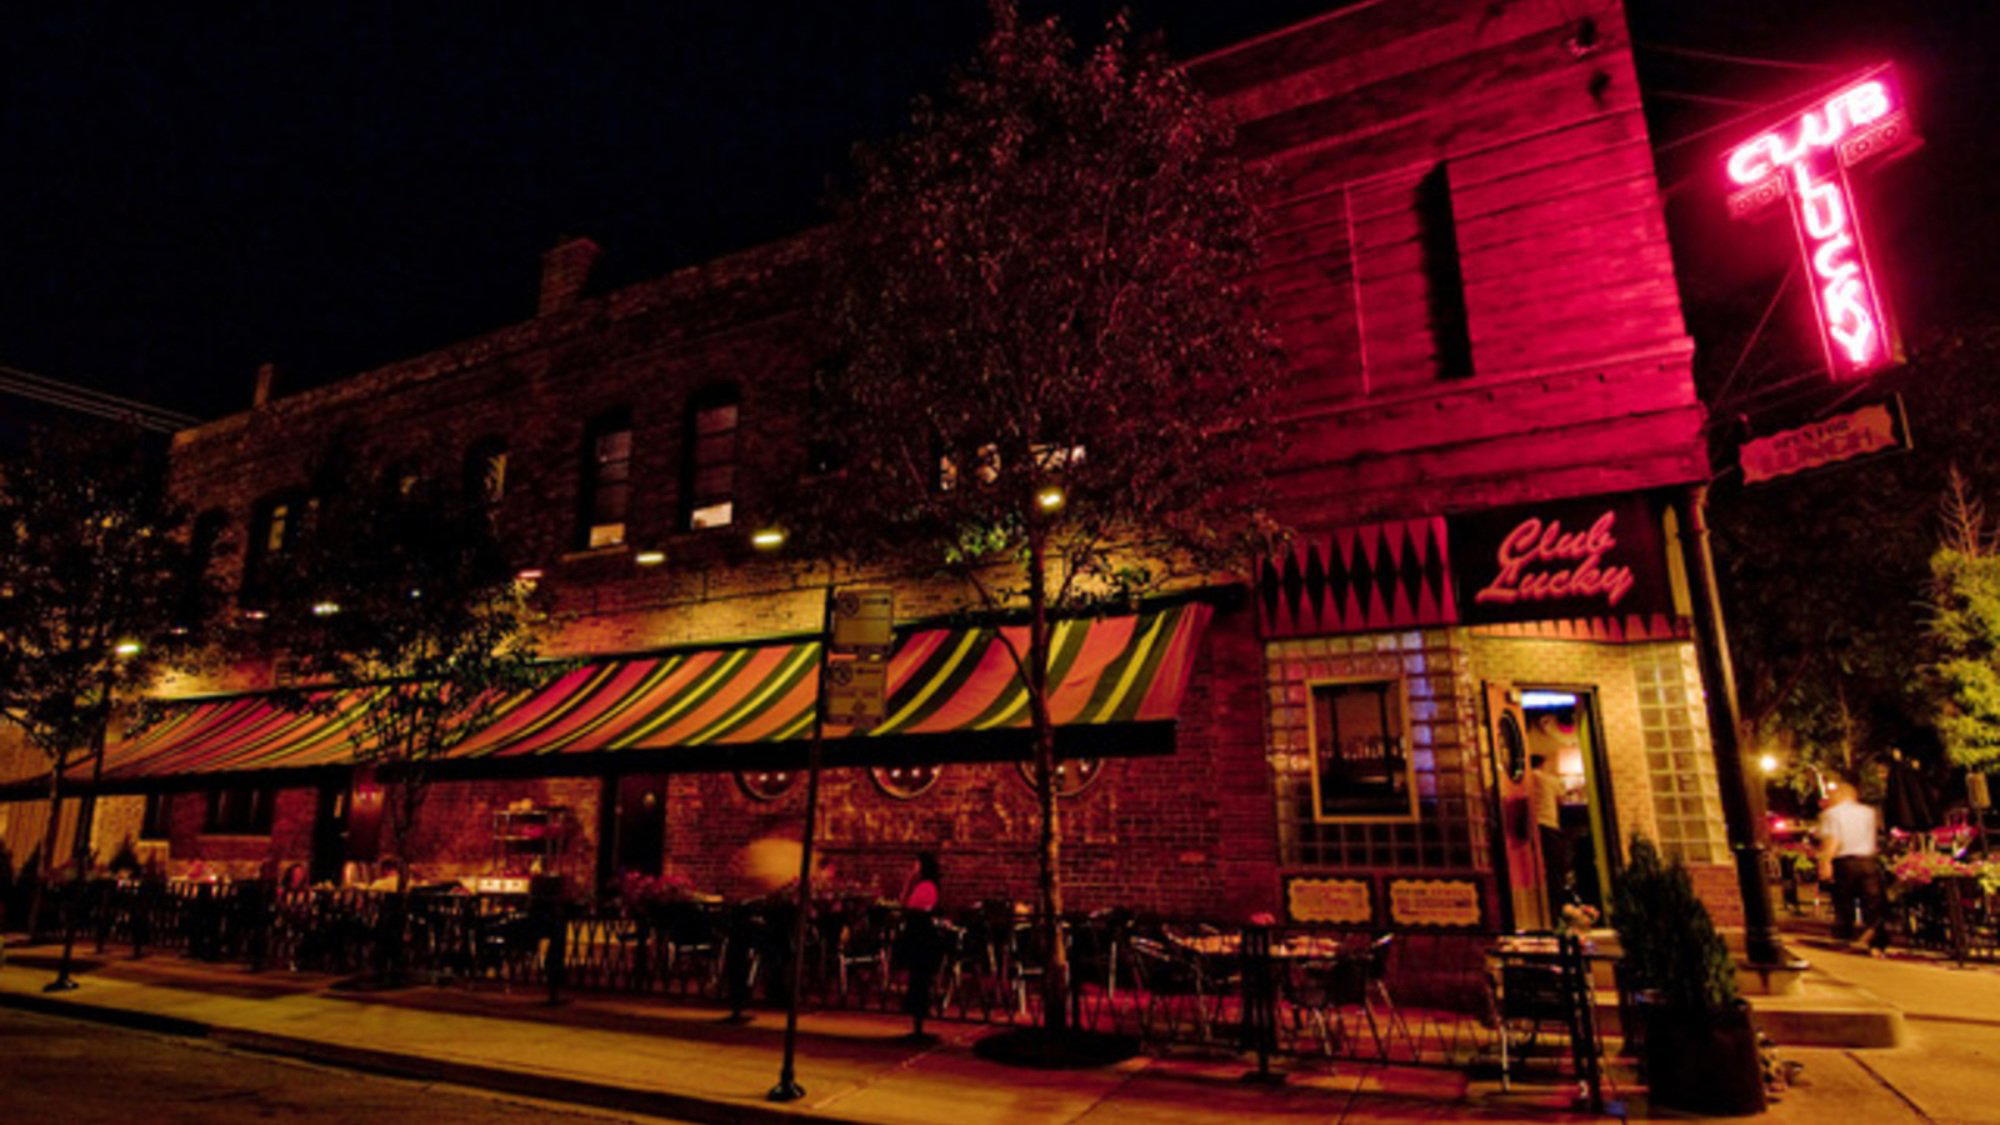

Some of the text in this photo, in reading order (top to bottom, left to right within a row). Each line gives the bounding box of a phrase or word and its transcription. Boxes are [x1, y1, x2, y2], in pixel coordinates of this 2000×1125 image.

[1727, 80, 1891, 185] CLUB
[1793, 157, 1878, 367] LUCKY
[1497, 509, 1617, 567] Club
[1474, 553, 1635, 608] Lucky
